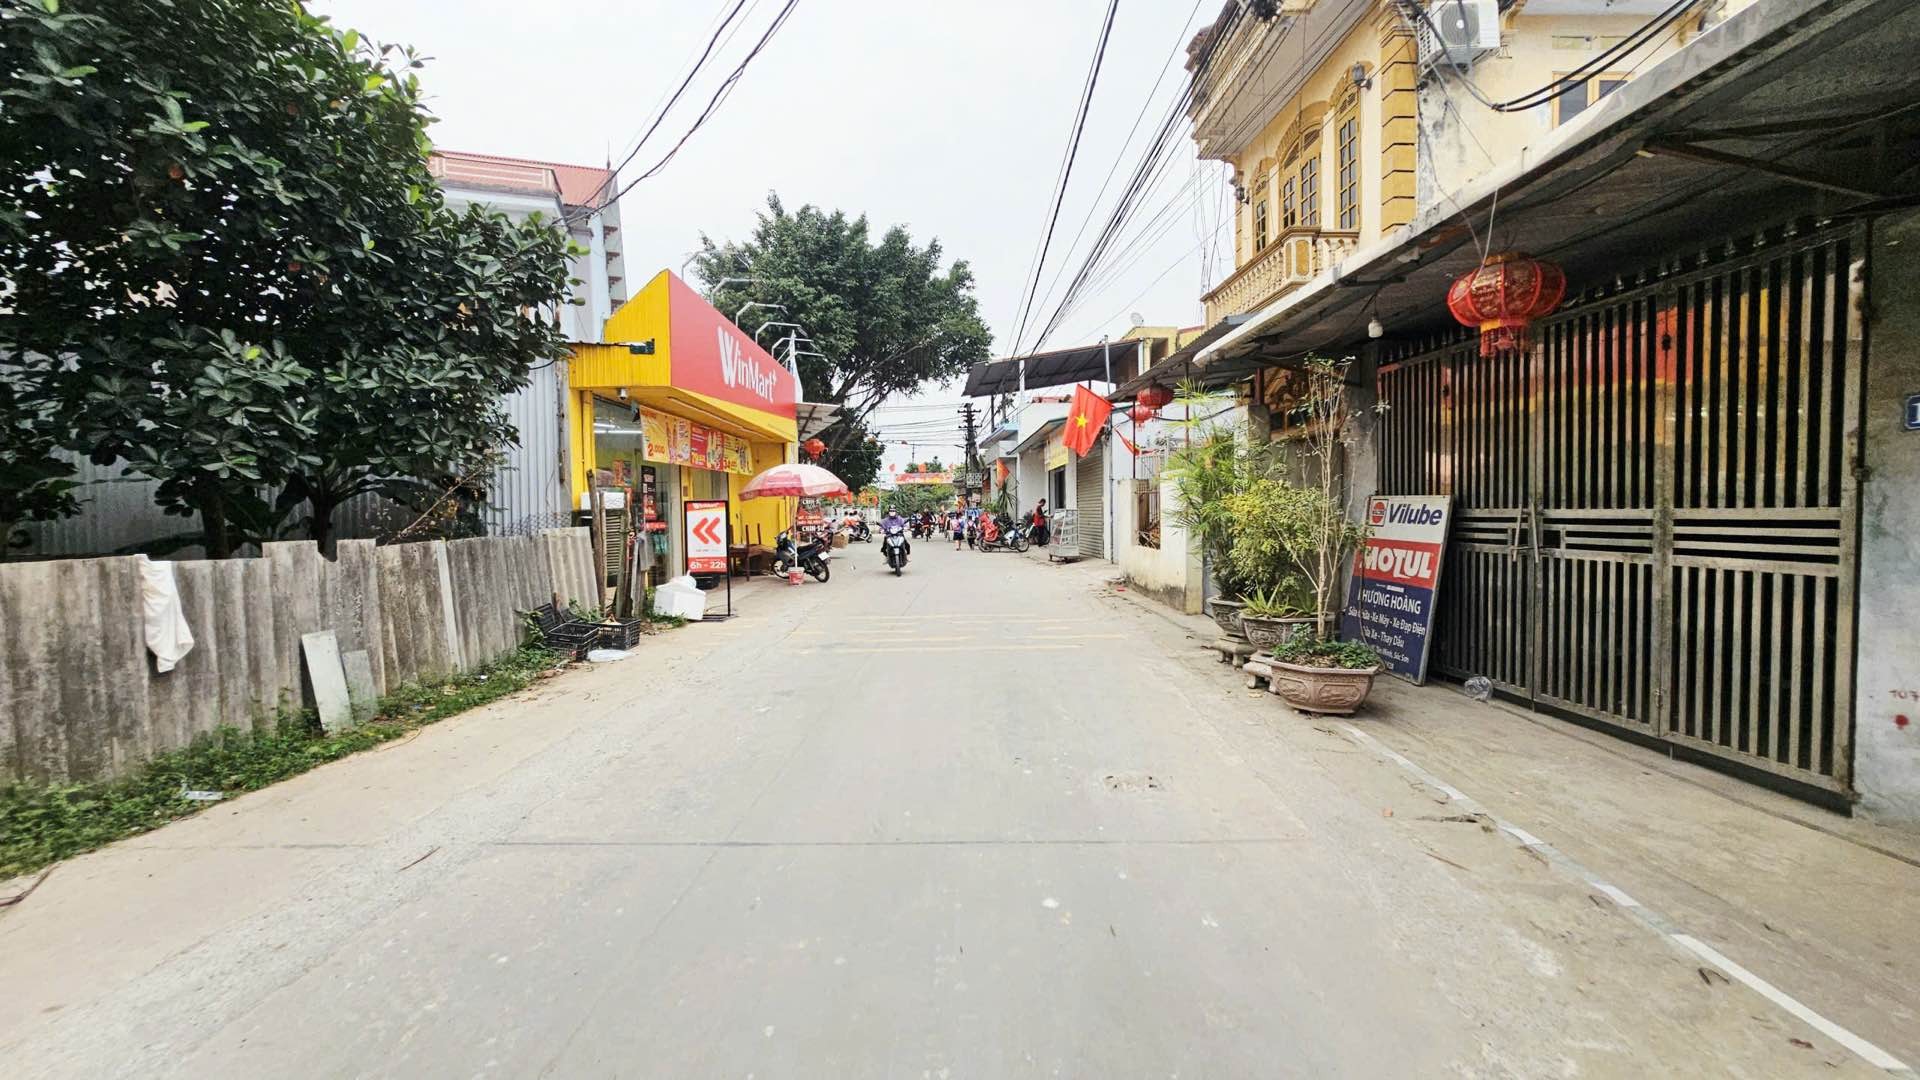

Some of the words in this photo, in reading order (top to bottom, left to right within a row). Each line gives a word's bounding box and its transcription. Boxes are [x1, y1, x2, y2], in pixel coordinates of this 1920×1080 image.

[1388, 504, 1443, 525] Vilube
[1359, 546, 1434, 579] MOTUL
[1390, 595, 1421, 615] HOÀNG
